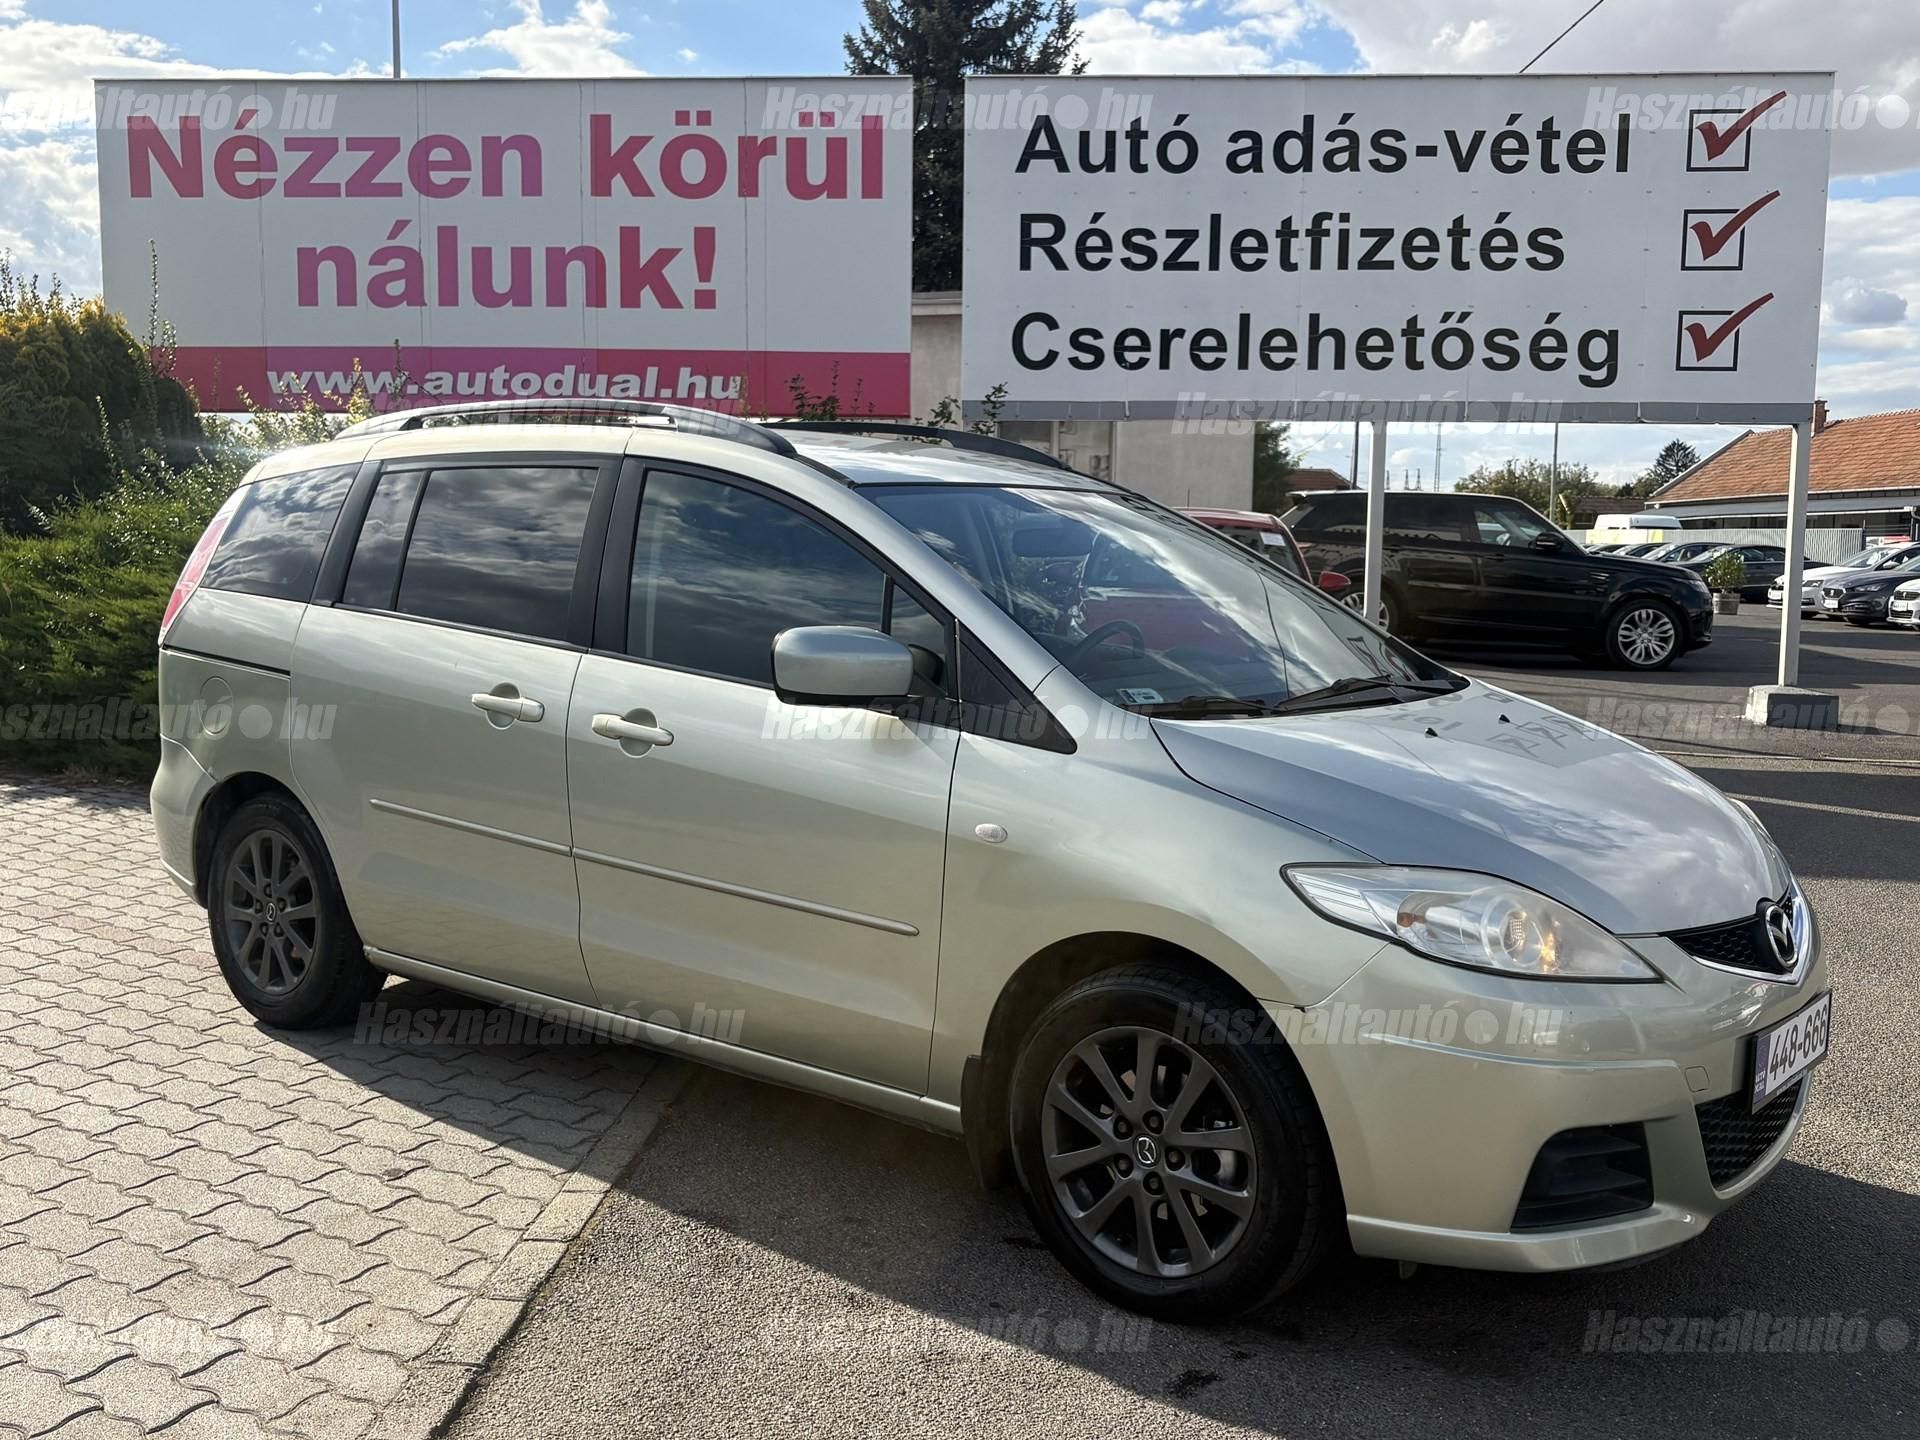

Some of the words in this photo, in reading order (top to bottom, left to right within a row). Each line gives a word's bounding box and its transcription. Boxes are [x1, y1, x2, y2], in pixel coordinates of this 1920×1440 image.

[127, 109, 543, 198] Nézzen
[590, 110, 884, 200] körül
[1015, 114, 1199, 174] Autó
[1225, 113, 1630, 174] adás-vétel
[297, 219, 718, 309] nálunk!
[1018, 211, 1565, 272] Részletfizetés
[267, 364, 742, 400] www.autodual.hu
[1011, 311, 1620, 388] Cserelehetőség
[1769, 1003, 1828, 1081] 448-666
